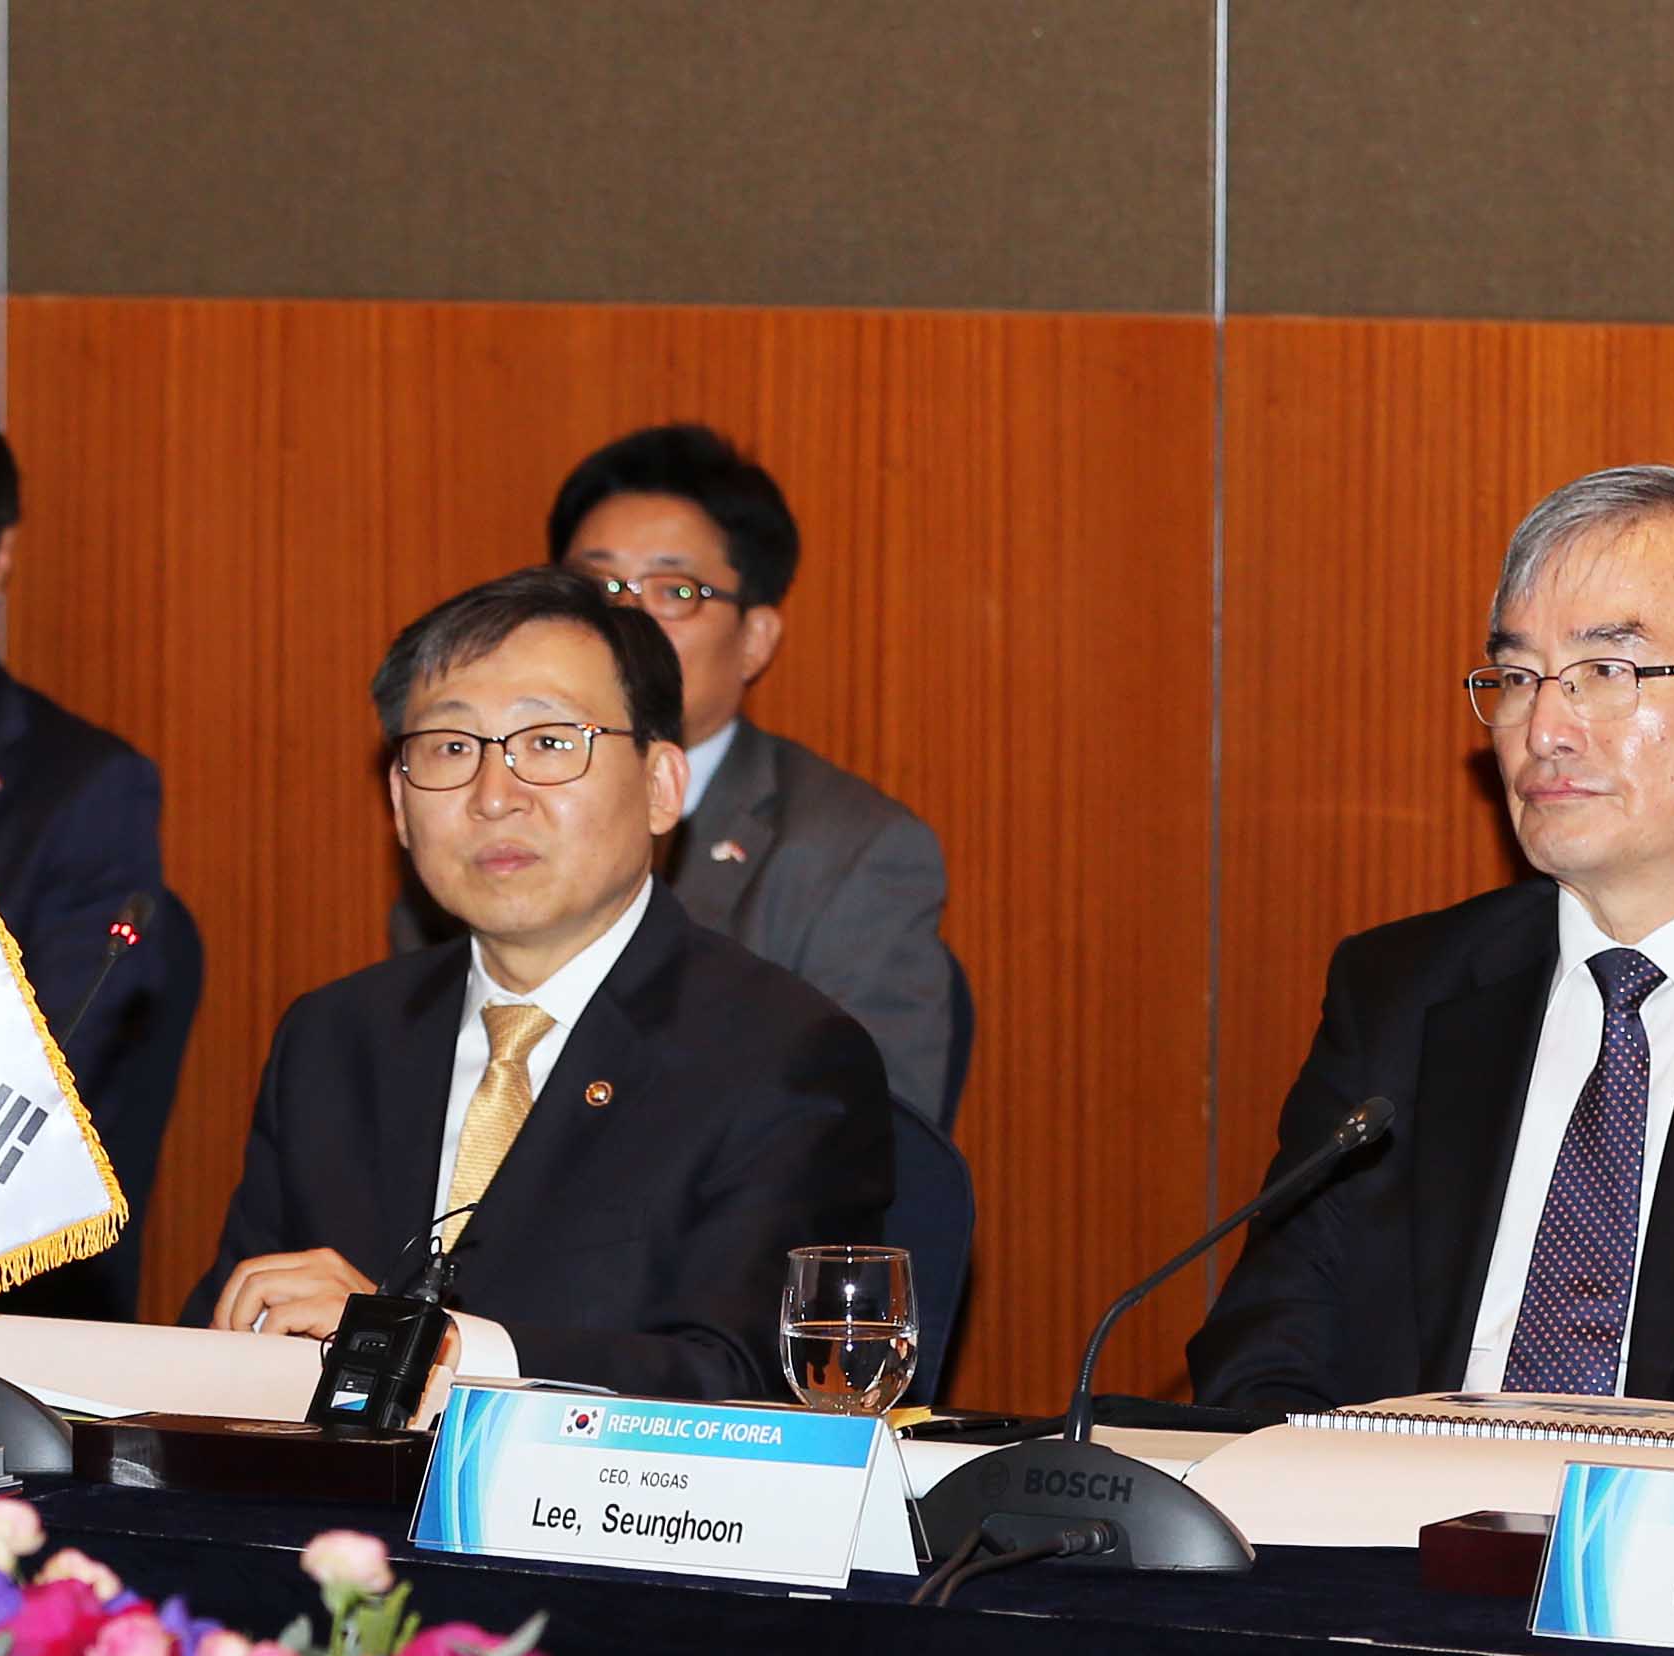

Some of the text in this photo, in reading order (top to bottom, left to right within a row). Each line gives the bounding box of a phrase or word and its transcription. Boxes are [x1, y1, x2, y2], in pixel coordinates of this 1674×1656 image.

[607, 1414, 783, 1446] REPUBLIC OF KOREA
[599, 1468, 689, 1490] CEO, KOGAS
[1024, 1468, 1134, 1504] BOSCH
[531, 1497, 743, 1545] Lee, Seunghoon
